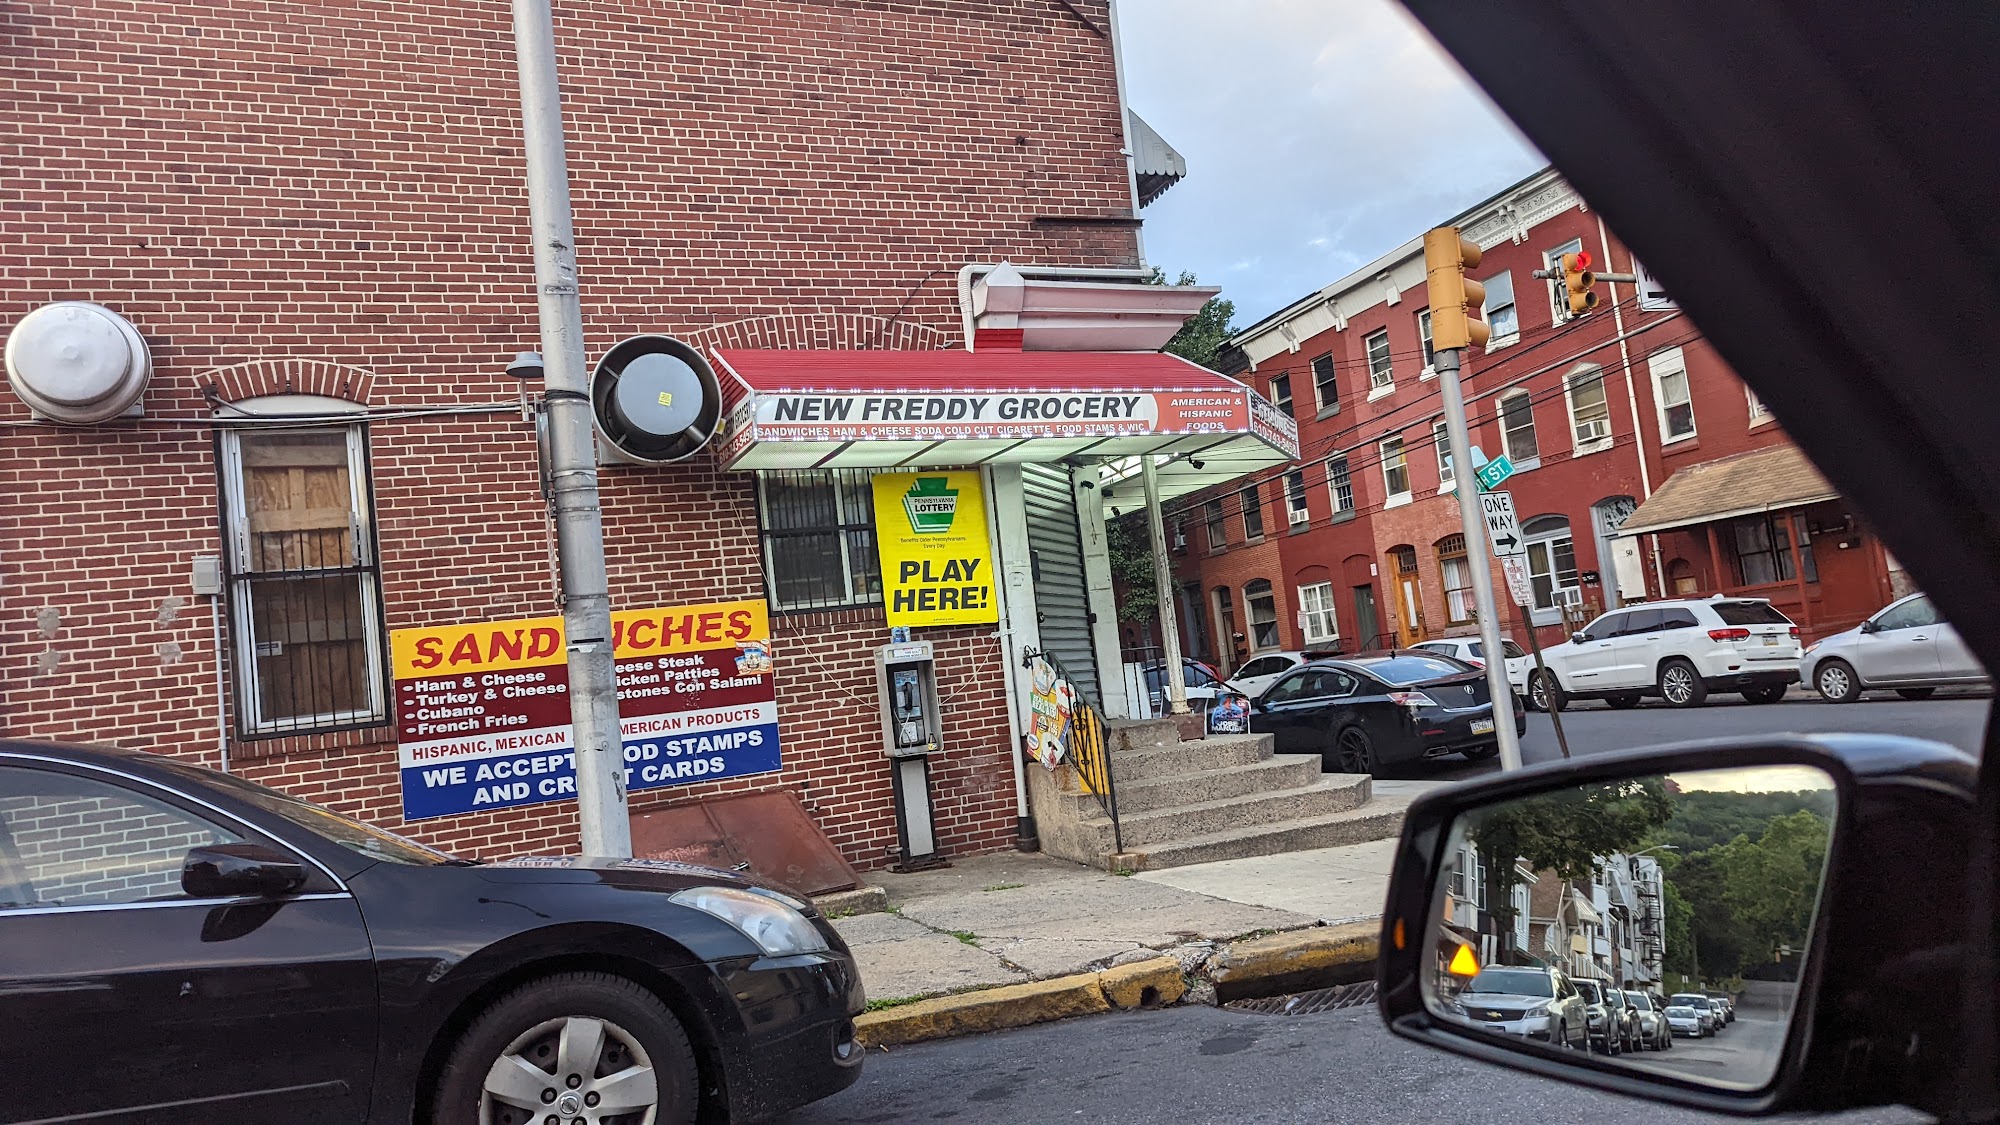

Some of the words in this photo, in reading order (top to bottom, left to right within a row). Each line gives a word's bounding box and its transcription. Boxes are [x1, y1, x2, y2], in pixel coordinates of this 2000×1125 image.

[774, 398, 854, 421] NEW
[861, 397, 990, 421] FREDDY
[998, 396, 1141, 420] GROCERY
[1171, 397, 1231, 406] AMERICAN
[1233, 397, 1242, 405] &
[1179, 409, 1233, 418] HISPANIC
[757, 427, 830, 437] SANDWICHES
[833, 427, 857, 436] HAM
[860, 427, 867, 436] &
[871, 426, 911, 436] CHEESE
[914, 426, 942, 435] SODA
[944, 426, 971, 435] COLD
[974, 425, 994, 434] CUT
[997, 425, 1050, 434] CIGARETTE
[1056, 424, 1082, 433] FOOD
[1084, 424, 1115, 433] STAMS
[1118, 423, 1125, 432] &
[1127, 422, 1145, 431] WIC
[1187, 421, 1224, 431] FOODS
[1488, 462, 1508, 480] ST.
[915, 504, 954, 512] LOTTERY
[1484, 497, 1510, 512] ONE
[1488, 514, 1513, 531] WAY
[899, 558, 981, 583] PLAY
[893, 586, 988, 612] HERE!
[411, 610, 752, 669] SANDICHES
[658, 655, 705, 669] Steak
[415, 680, 456, 692] Ham
[462, 676, 476, 688] &
[481, 672, 546, 686] Cheese
[664, 668, 720, 682] Patties
[675, 681, 705, 694] Con
[710, 674, 762, 690] Salami
[416, 691, 478, 706] Turkey
[484, 688, 497, 700] &
[503, 683, 567, 698] Cheese
[417, 705, 485, 720] Cubano
[620, 718, 681, 735] MERICAN
[687, 708, 760, 727] PRODUCTS
[418, 719, 480, 735] French
[485, 714, 528, 728] Fries
[412, 740, 492, 760] HISPANIC,
[495, 731, 565, 750] MEXICAN
[666, 729, 763, 757] STAMPS
[422, 767, 467, 788] WE
[475, 752, 577, 782] ACCEPT
[472, 782, 531, 805] AND
[641, 757, 725, 782] CARDS
